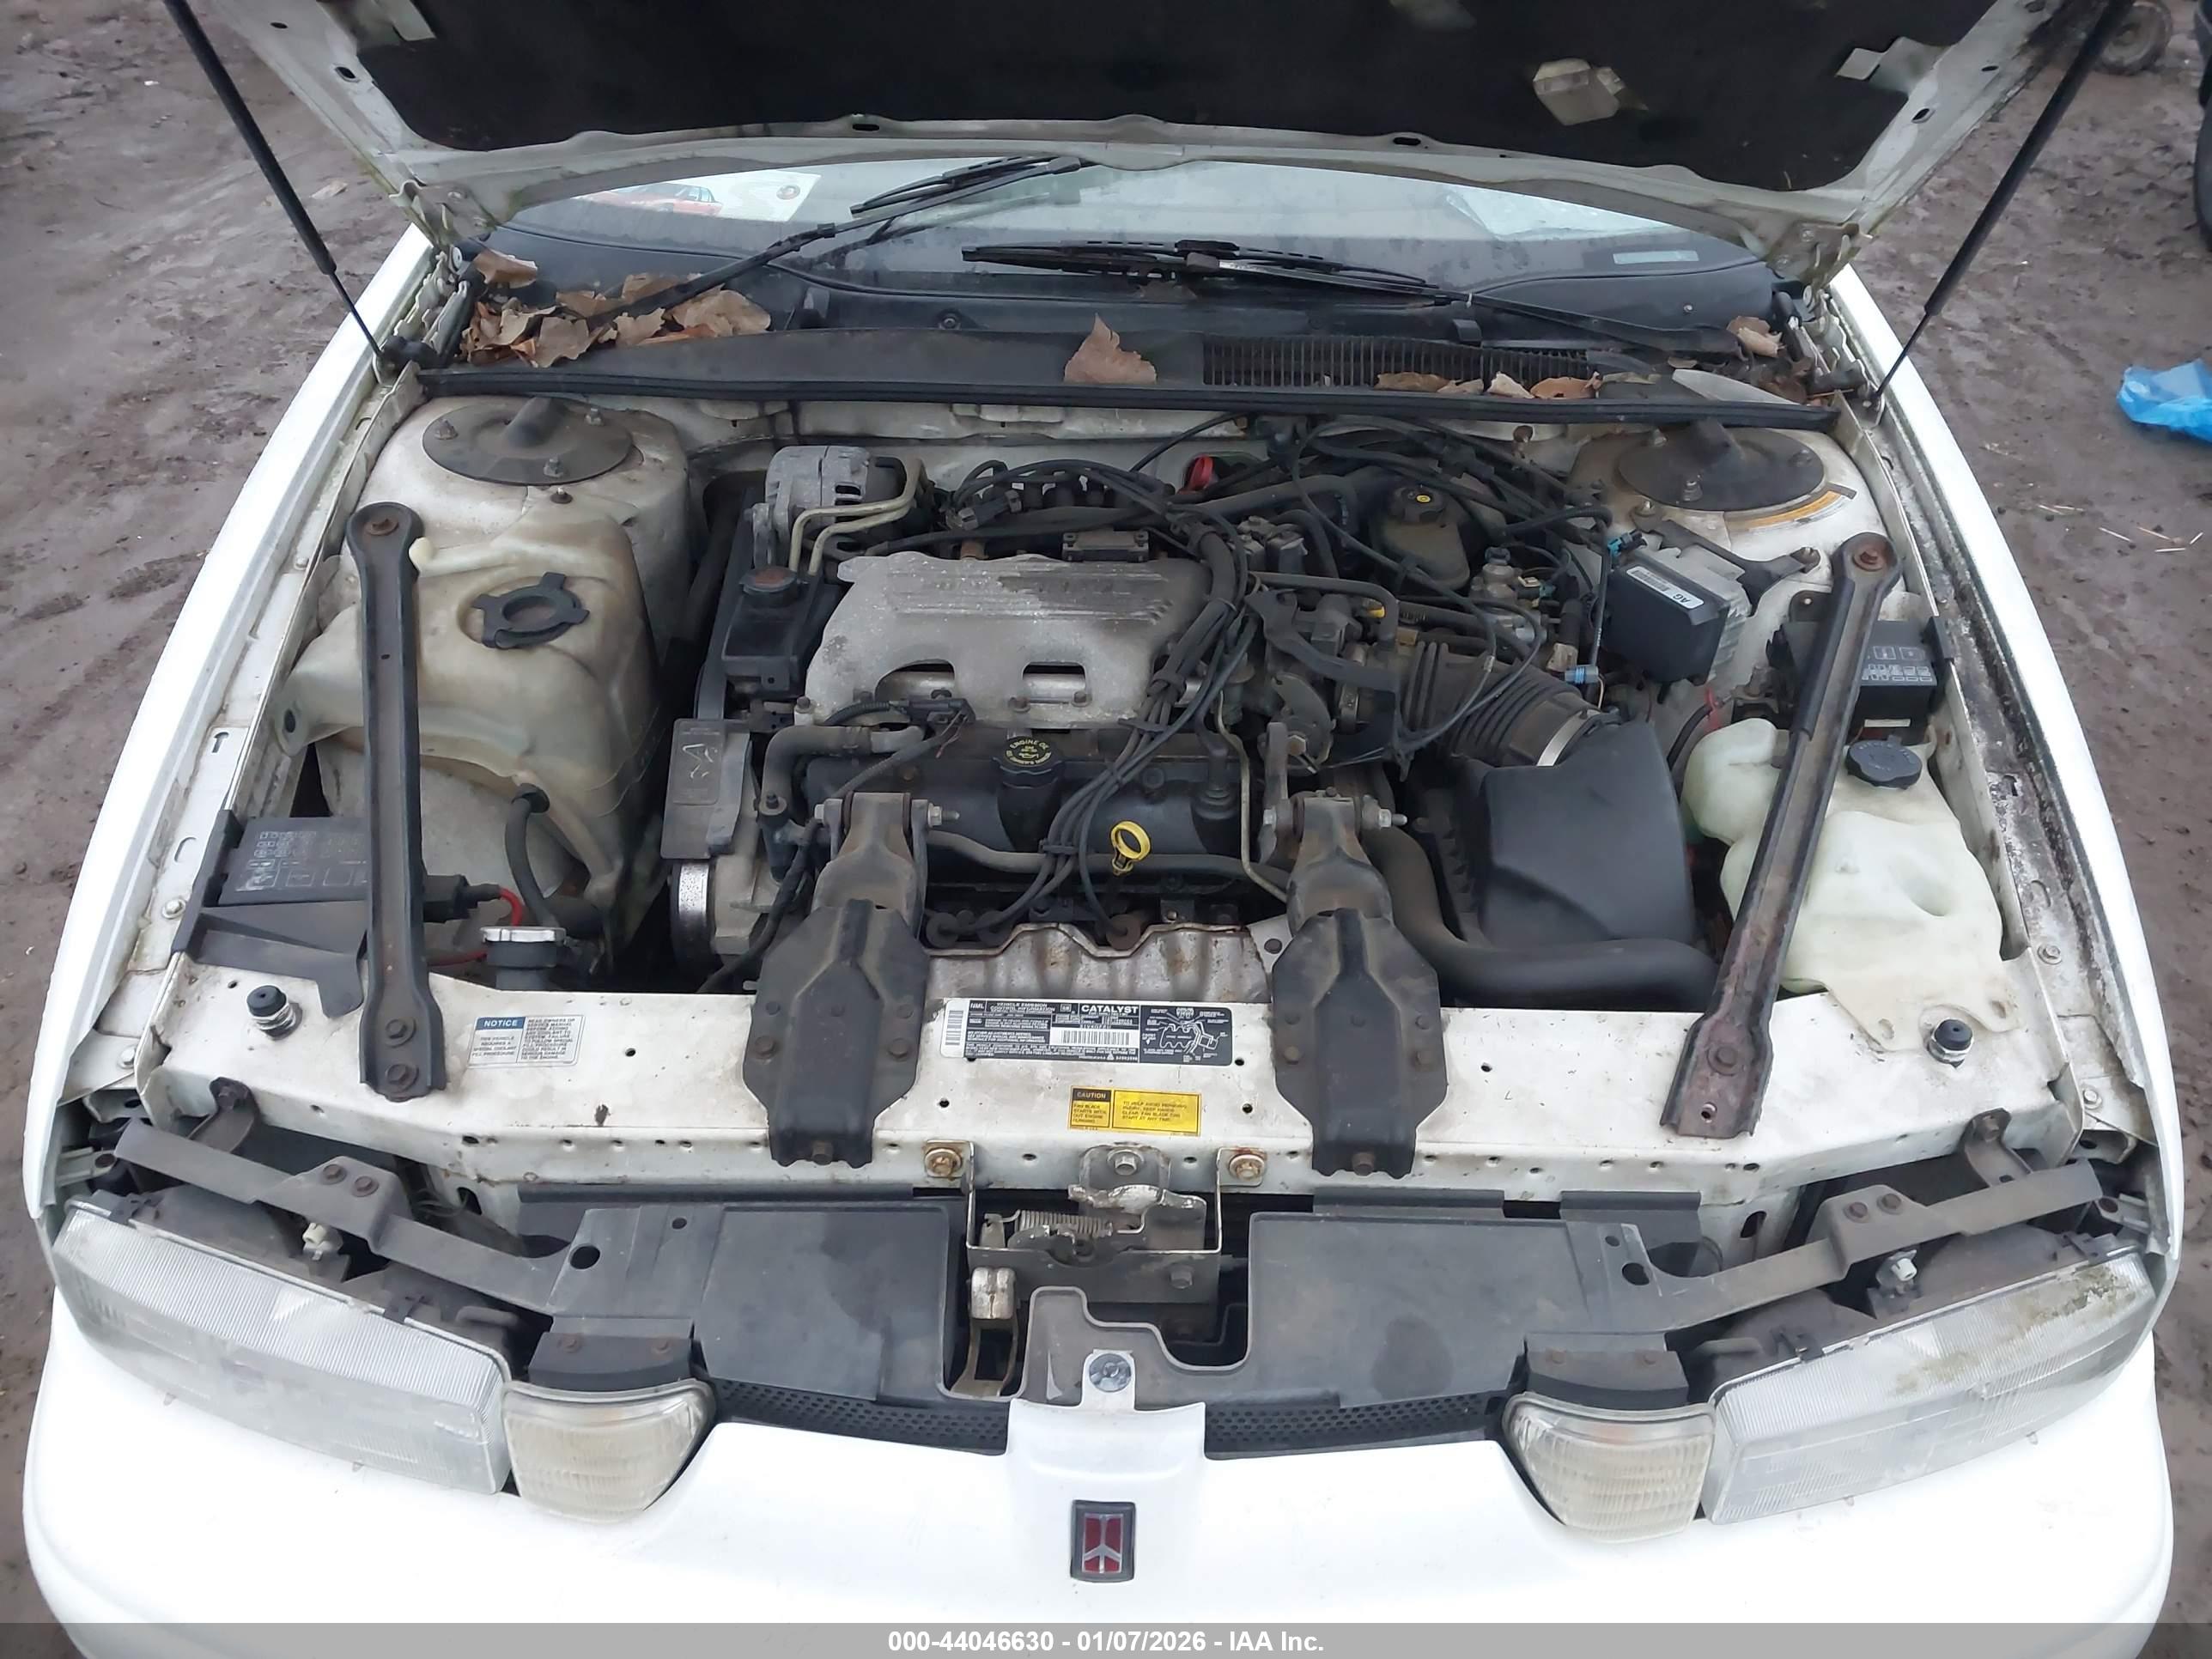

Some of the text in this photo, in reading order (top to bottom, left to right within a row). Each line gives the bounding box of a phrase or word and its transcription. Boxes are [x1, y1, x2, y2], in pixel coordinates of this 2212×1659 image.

[1673, 594, 1690, 603] AG
[1010, 739, 1039, 748] ENGINE
[1082, 1005, 1138, 1013] CATALYST
